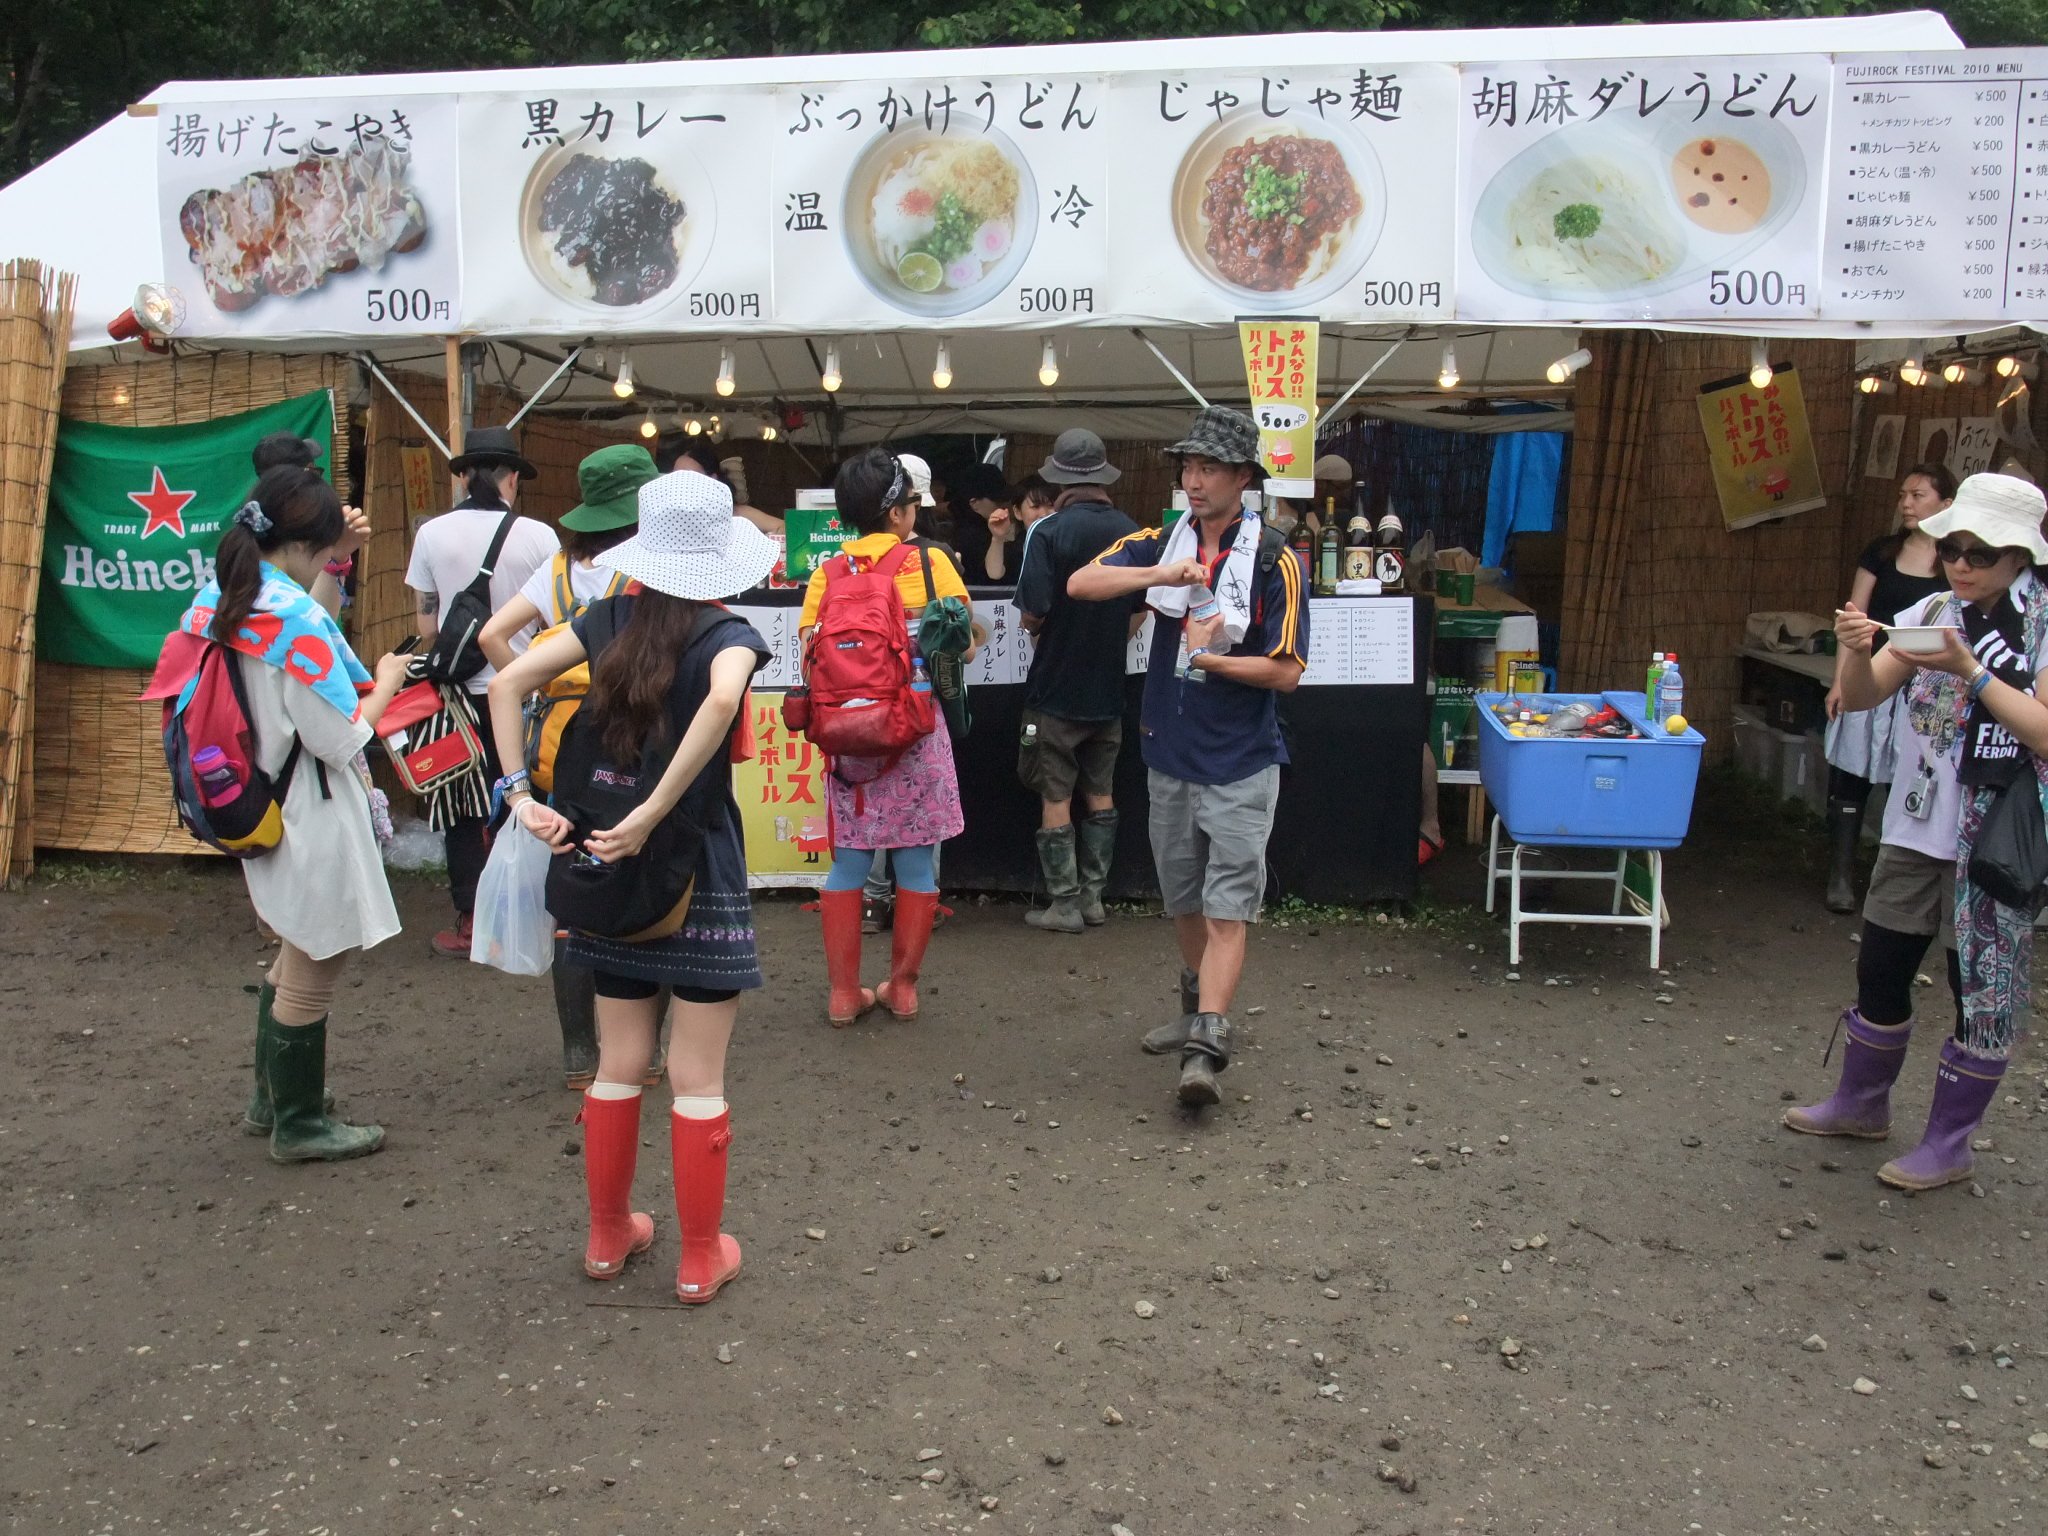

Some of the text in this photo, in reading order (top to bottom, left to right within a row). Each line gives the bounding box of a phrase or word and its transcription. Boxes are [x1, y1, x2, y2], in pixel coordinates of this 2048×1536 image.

[1846, 63, 2023, 77] FUJIROCK FESTIVAL 2010 MENU
[789, 81, 1097, 136] ぶっかけうどん
[1159, 68, 1402, 123] じゃじゃ麺
[1471, 70, 1817, 127] 胡麻ダレうどん
[1861, 91, 1911, 105] 黒カレー
[165, 108, 413, 159] 揚げたこやき
[521, 97, 727, 149] 黒カレー
[1859, 141, 1941, 154] 黒カレーうどん
[784, 192, 828, 232] 温
[1050, 189, 1096, 230] 冷
[1856, 190, 1911, 204] じゃじゃ麺
[1855, 215, 1937, 228] 胡麻ダレうどん
[1853, 239, 1926, 253] 揚げたこやき
[1709, 270, 1806, 307] 500円
[1851, 264, 1889, 277] おでん
[367, 287, 450, 322] 500円
[690, 292, 760, 318] 500円
[1019, 287, 1094, 313] 500円
[1364, 281, 1441, 308] 500円
[1850, 288, 1905, 300] メンチカツ
[1249, 330, 1263, 397] ハイボール
[1266, 330, 1286, 398] トリス
[1718, 397, 1748, 468] ハイボール
[1739, 392, 1773, 464] トリス
[104, 521, 221, 535] TRADE MARK
[809, 533, 858, 543] Heineken
[806, 550, 845, 571] ¥6
[771, 612, 783, 680] メンチカツ
[993, 604, 1007, 658] 胡麻ダレ
[791, 635, 800, 684] 500円
[983, 645, 994, 683] うどん
[758, 707, 782, 804] ハイボール
[785, 731, 817, 804] リス
